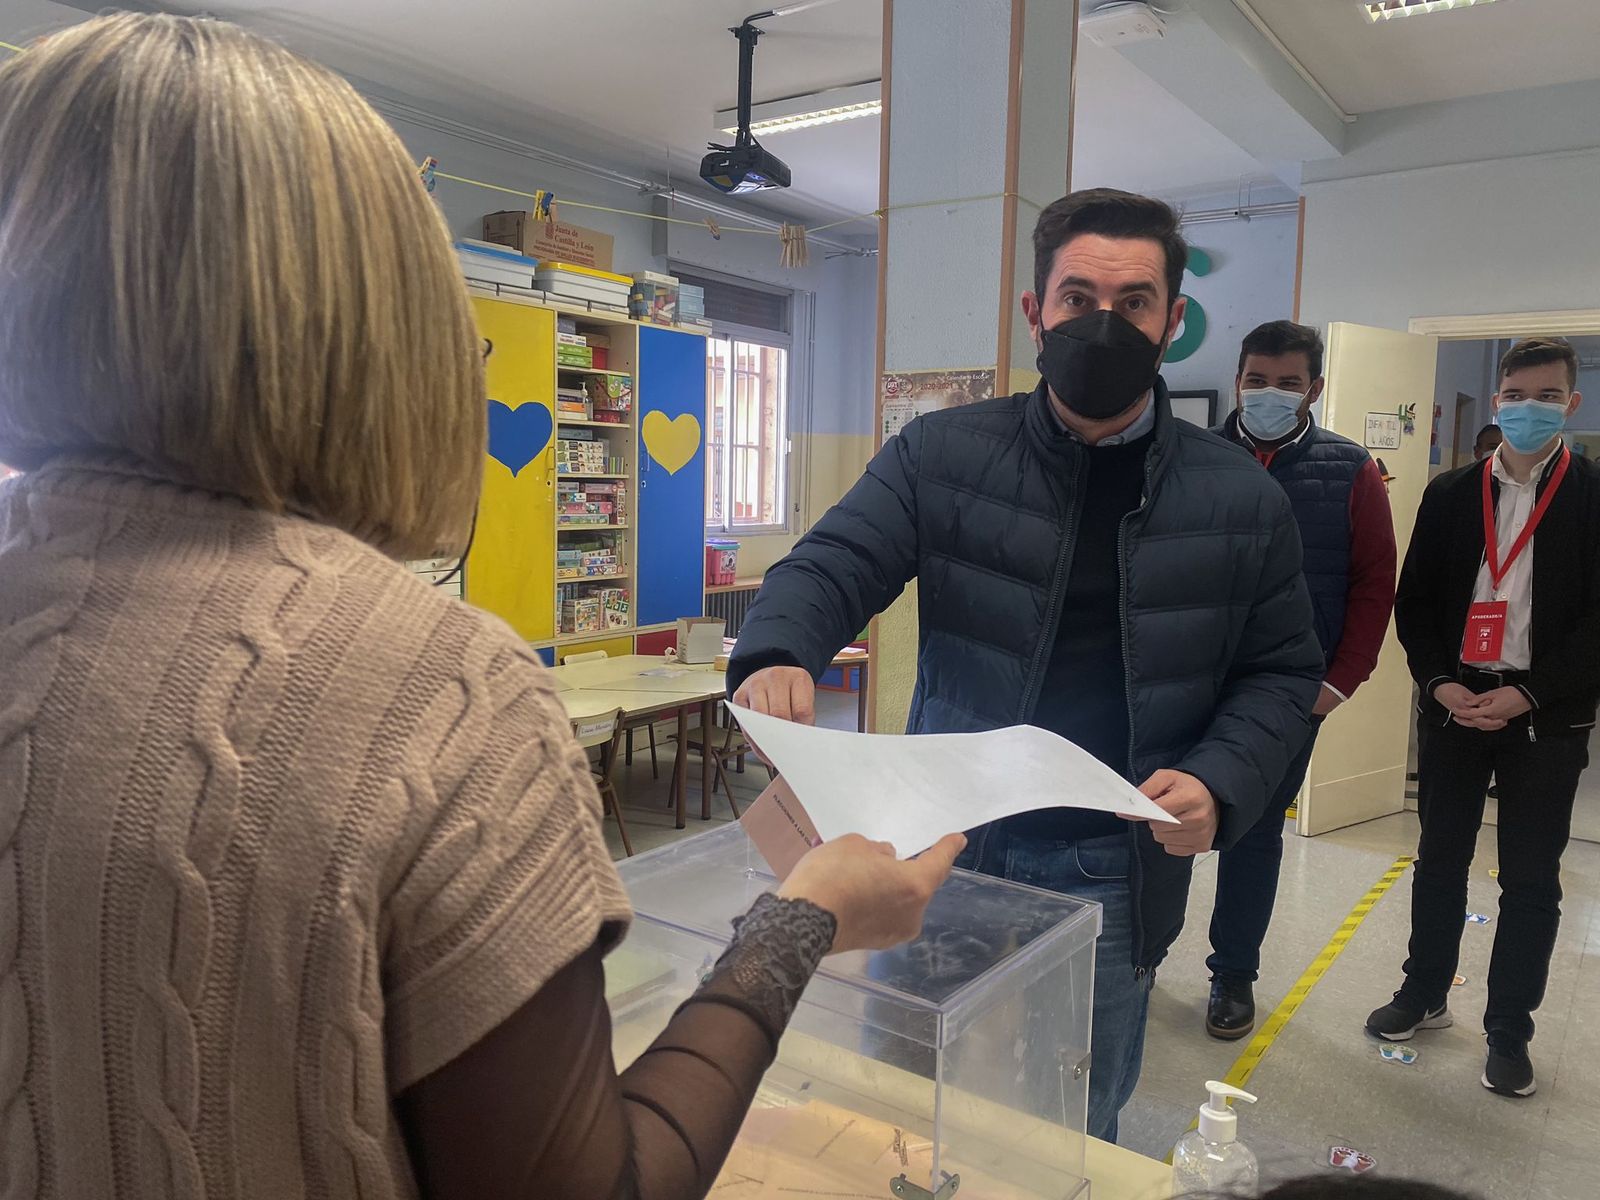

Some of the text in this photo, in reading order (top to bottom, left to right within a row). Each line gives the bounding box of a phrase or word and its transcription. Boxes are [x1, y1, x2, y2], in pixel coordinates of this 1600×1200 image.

[554, 224, 579, 237] Junta de
[554, 234, 576, 247] Castilla
